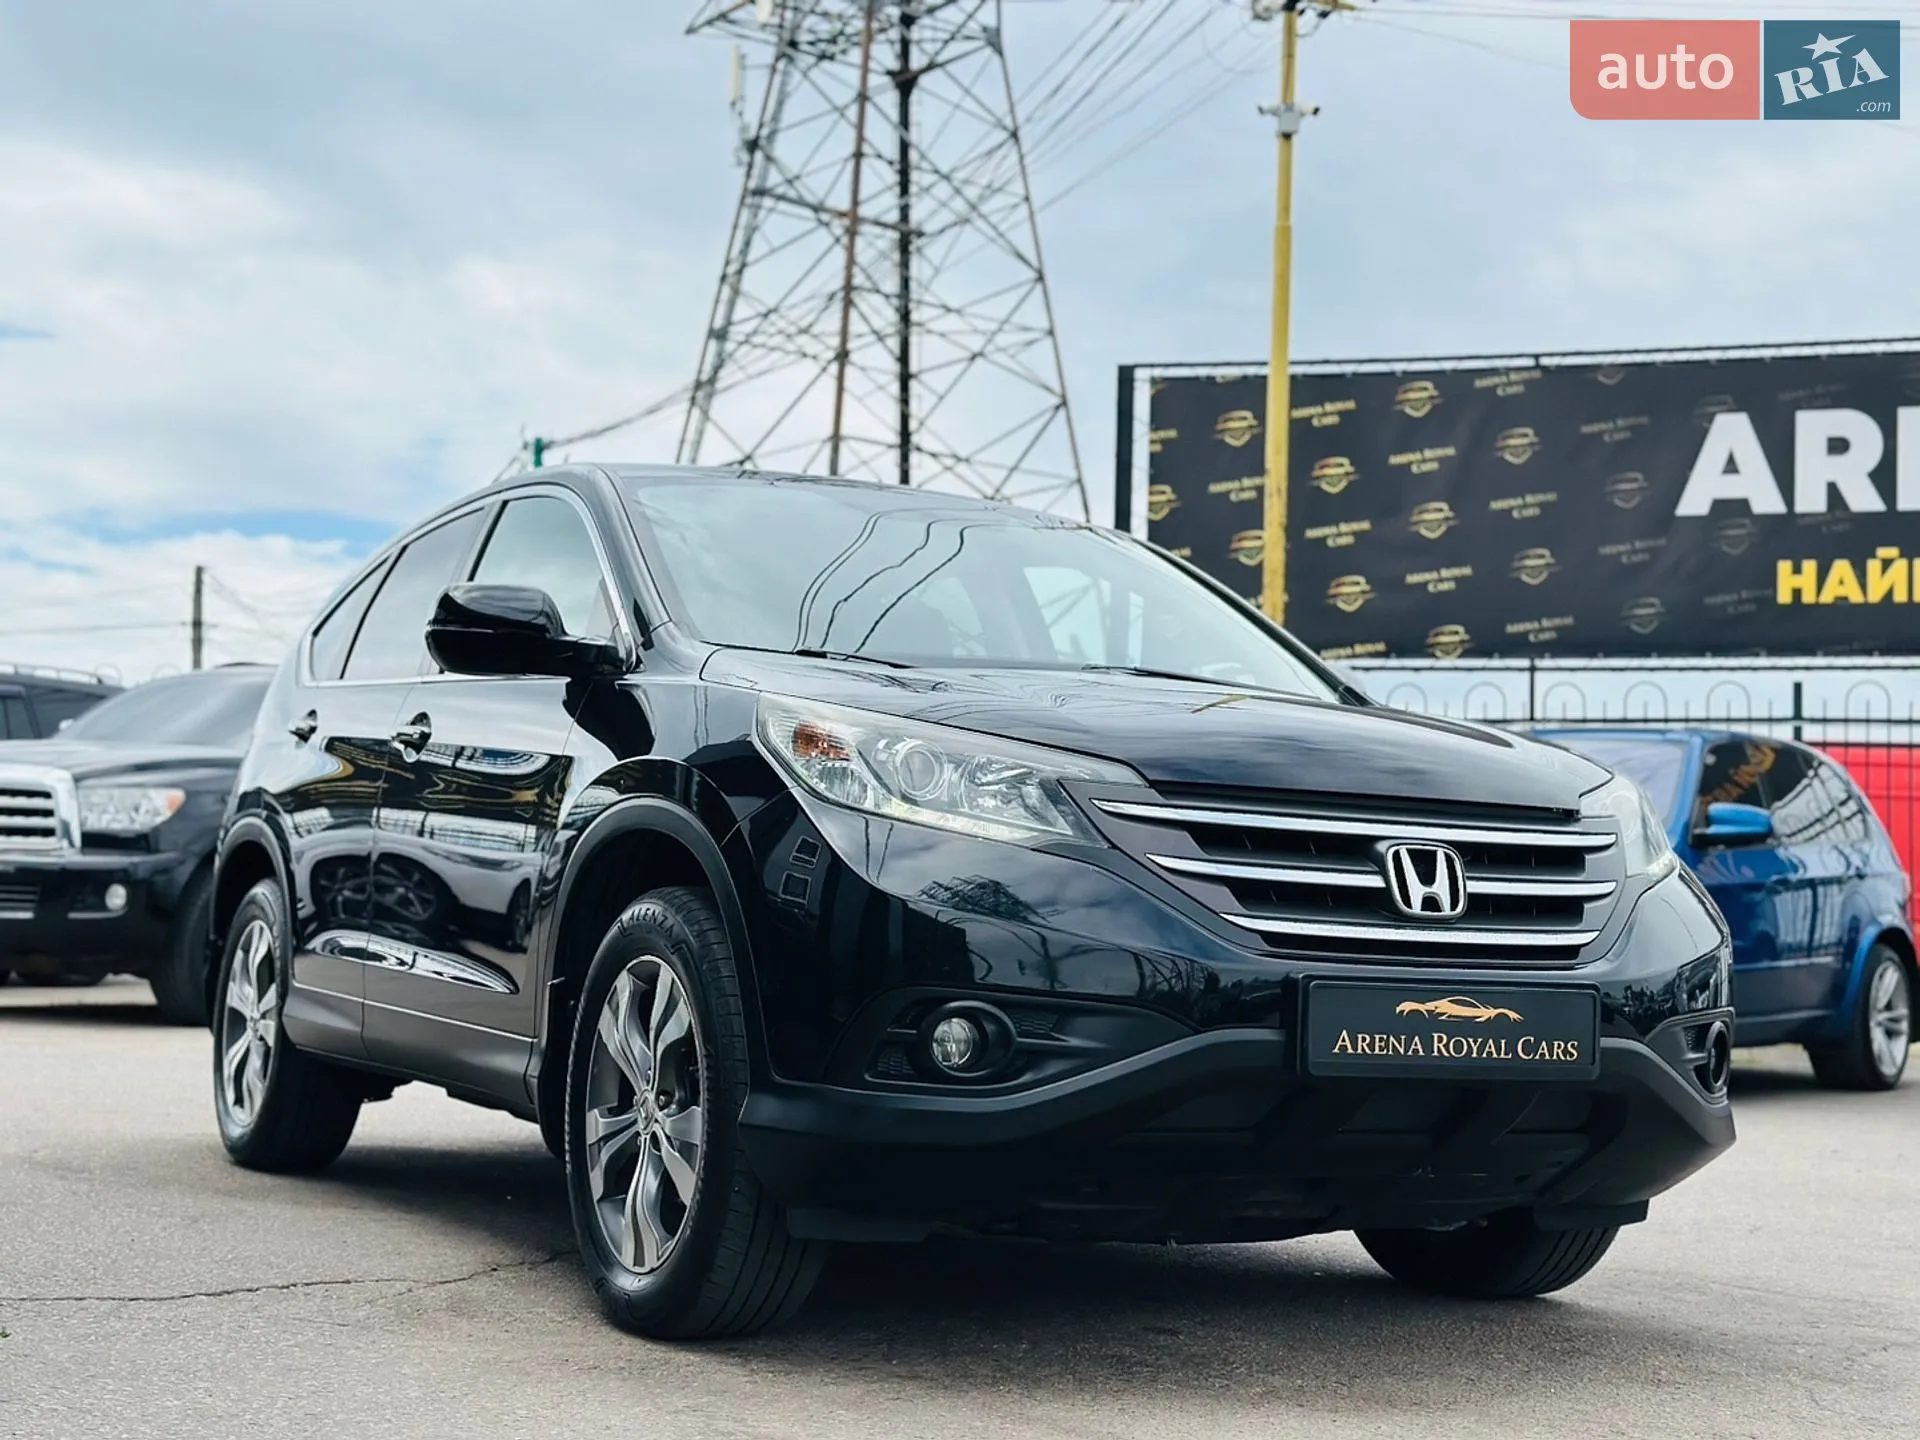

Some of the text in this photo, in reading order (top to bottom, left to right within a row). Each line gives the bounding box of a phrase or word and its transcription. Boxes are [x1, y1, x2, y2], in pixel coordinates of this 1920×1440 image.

[1776, 546, 1920, 605] НАЙ
[629, 907, 675, 938] ALENZA
[1332, 1029, 1578, 1061] ARENA ROYAL CARS
